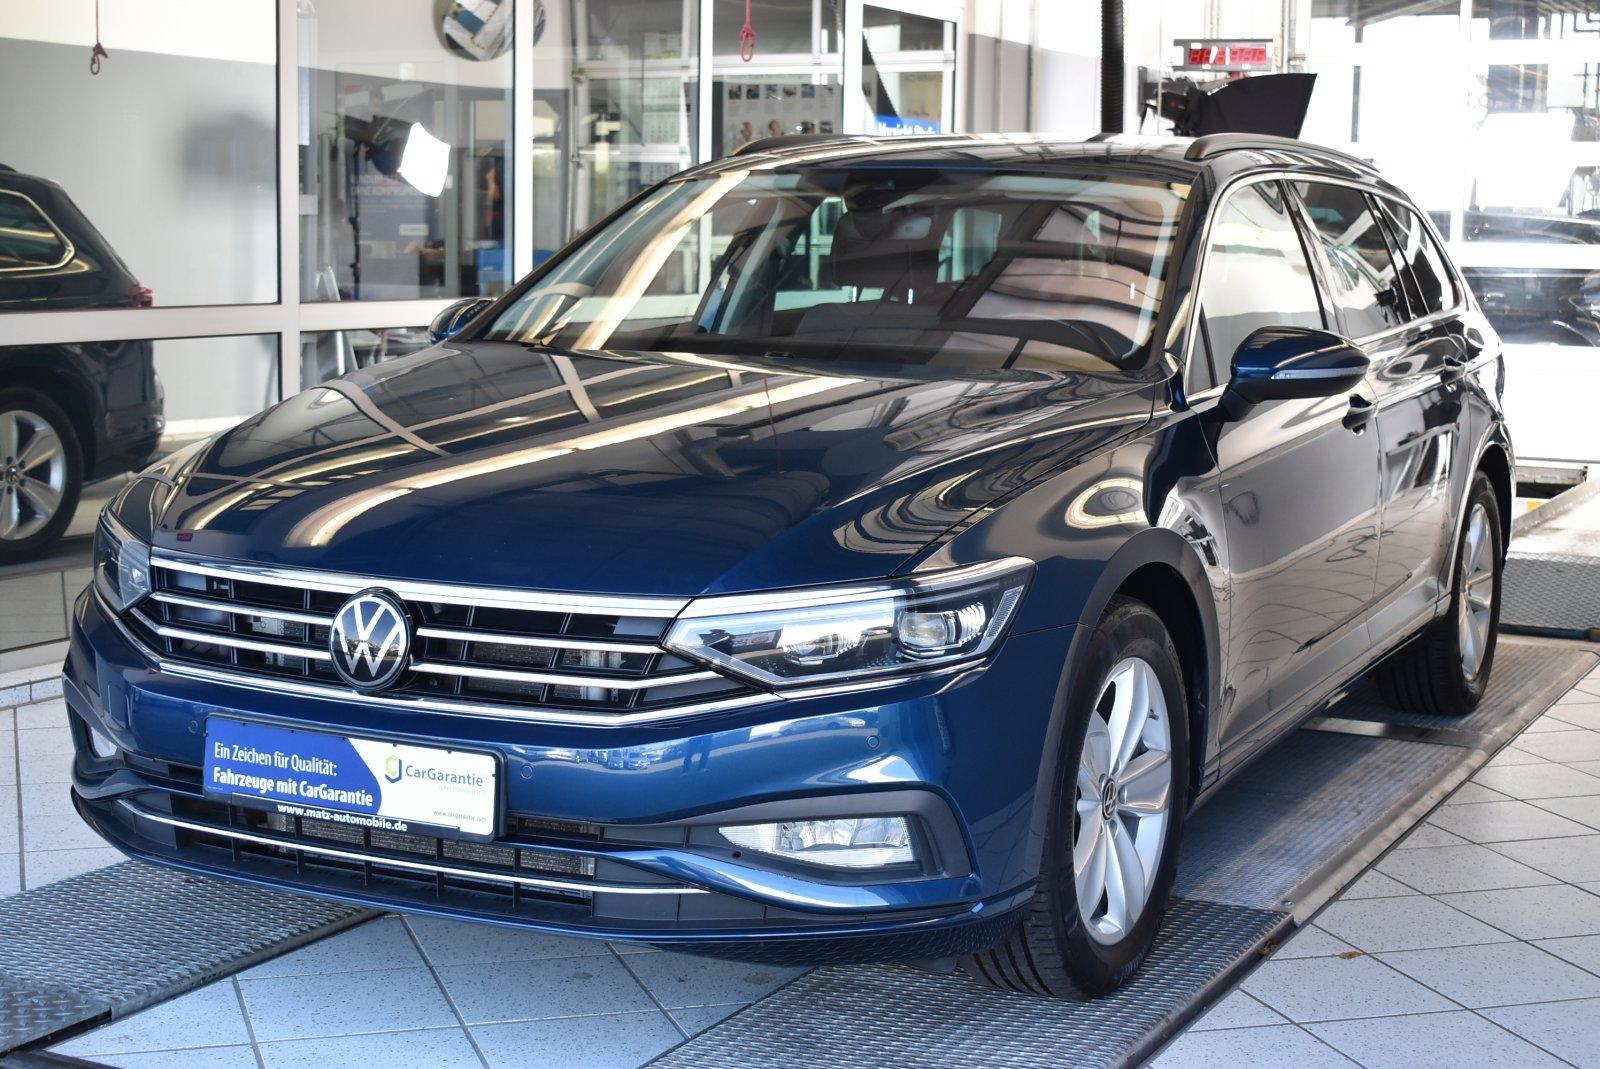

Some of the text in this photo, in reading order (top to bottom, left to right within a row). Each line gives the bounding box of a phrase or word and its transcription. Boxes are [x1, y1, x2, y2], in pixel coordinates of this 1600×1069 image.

[331, 596, 407, 686] VW
[214, 741, 337, 776] Ein Zeichen für Qualität:
[405, 765, 483, 787] CarGarantie
[213, 766, 373, 807] Fahrzeuge mit CarGarantie
[277, 804, 408, 832] www.matz-automobile.de
